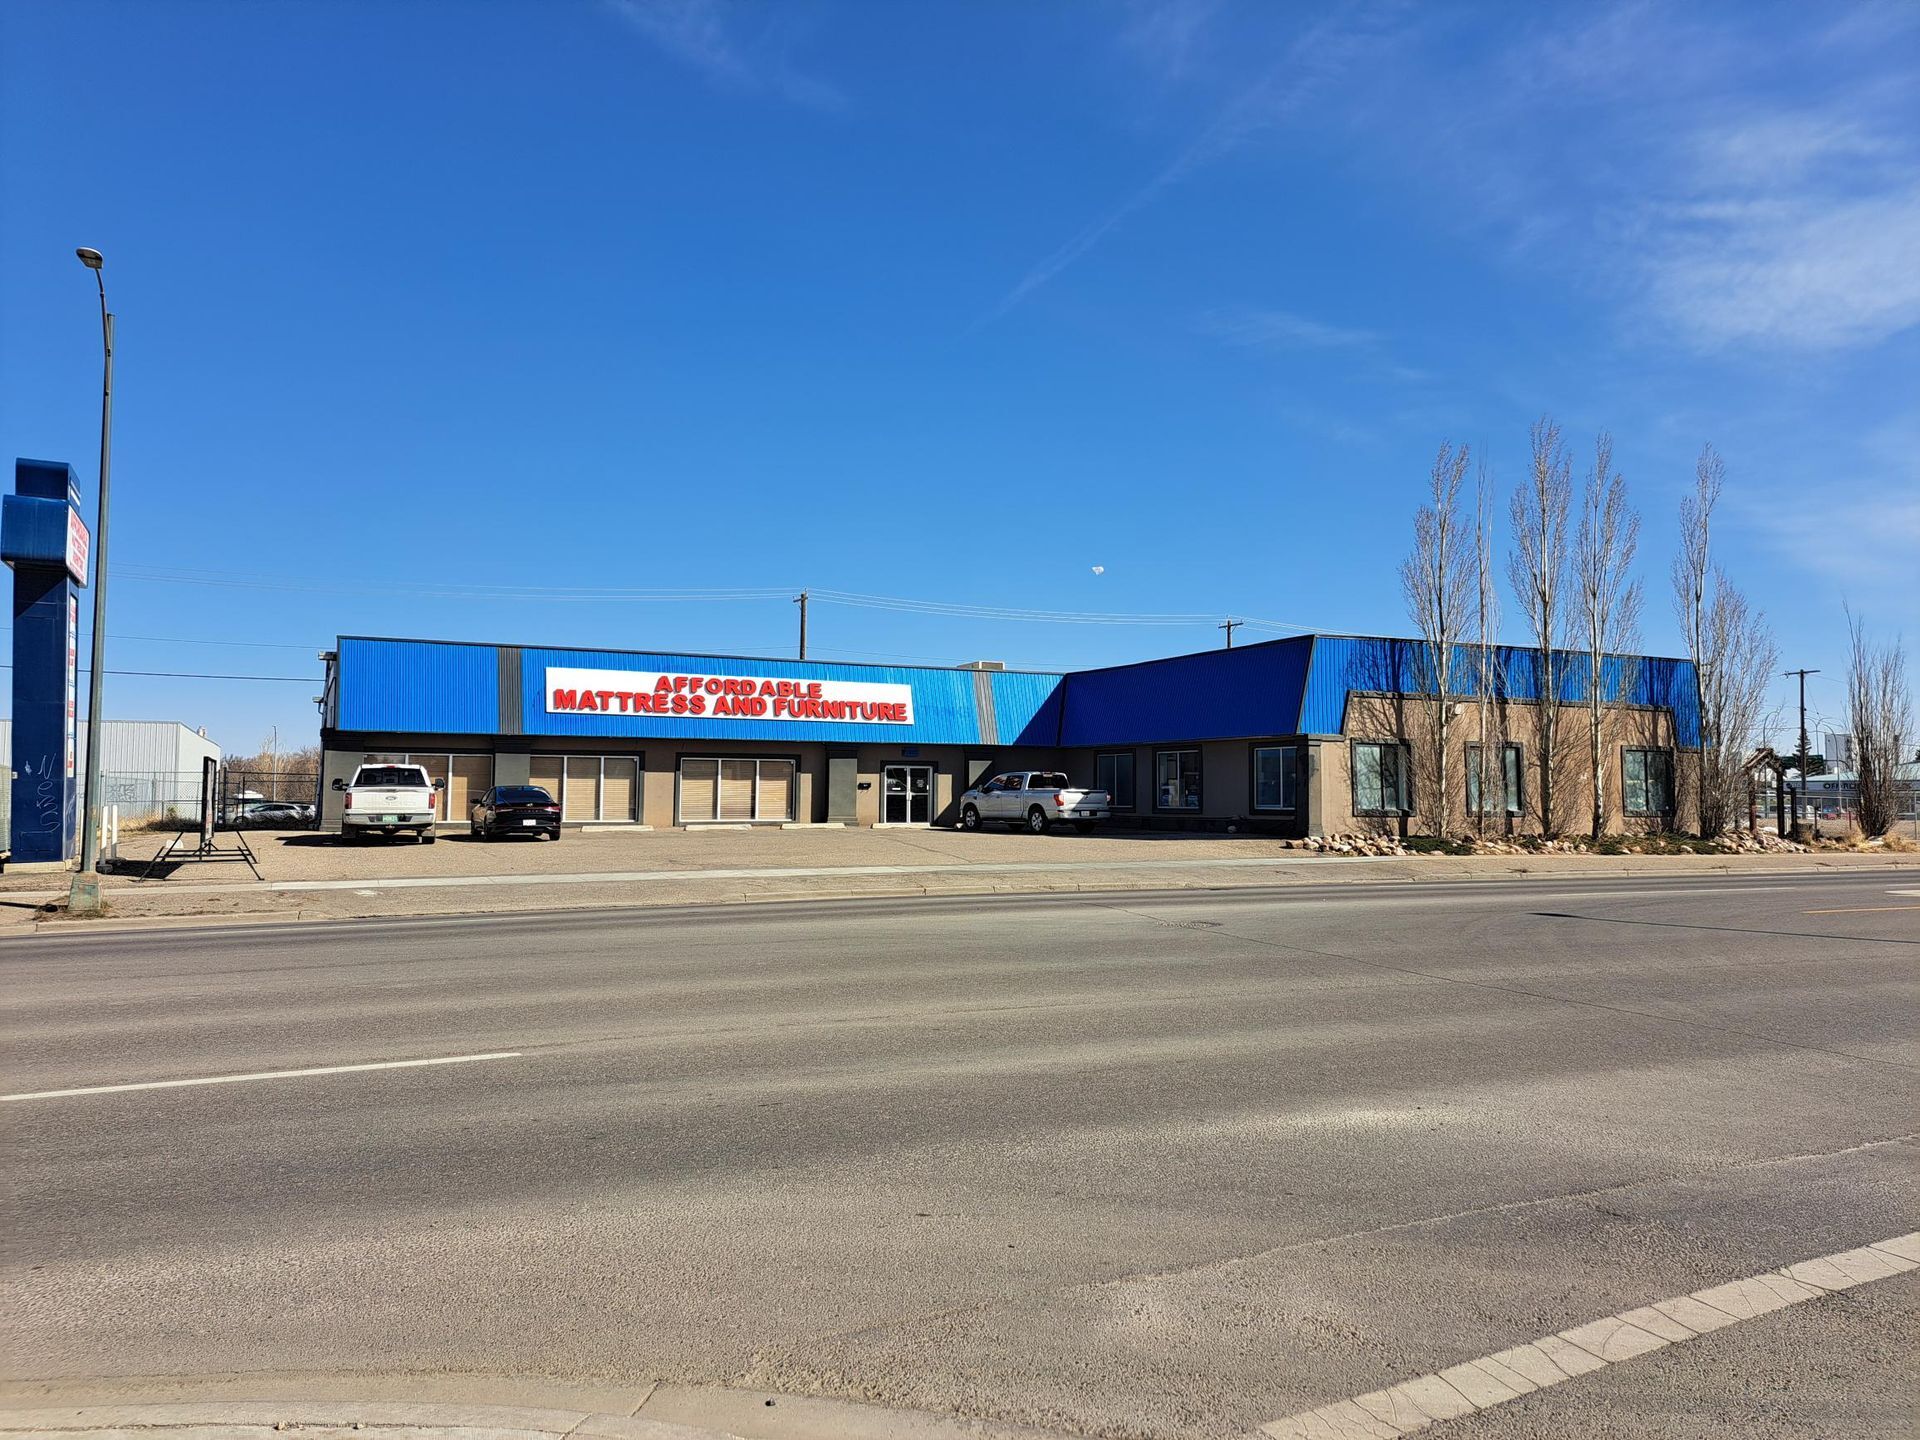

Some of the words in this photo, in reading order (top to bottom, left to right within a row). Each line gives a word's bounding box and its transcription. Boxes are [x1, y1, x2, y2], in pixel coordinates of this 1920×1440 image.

[654, 676, 822, 698] AFFORDABLE
[553, 689, 707, 714] MATTRESS
[712, 695, 767, 716] AND
[774, 699, 908, 721] FURNITURE
